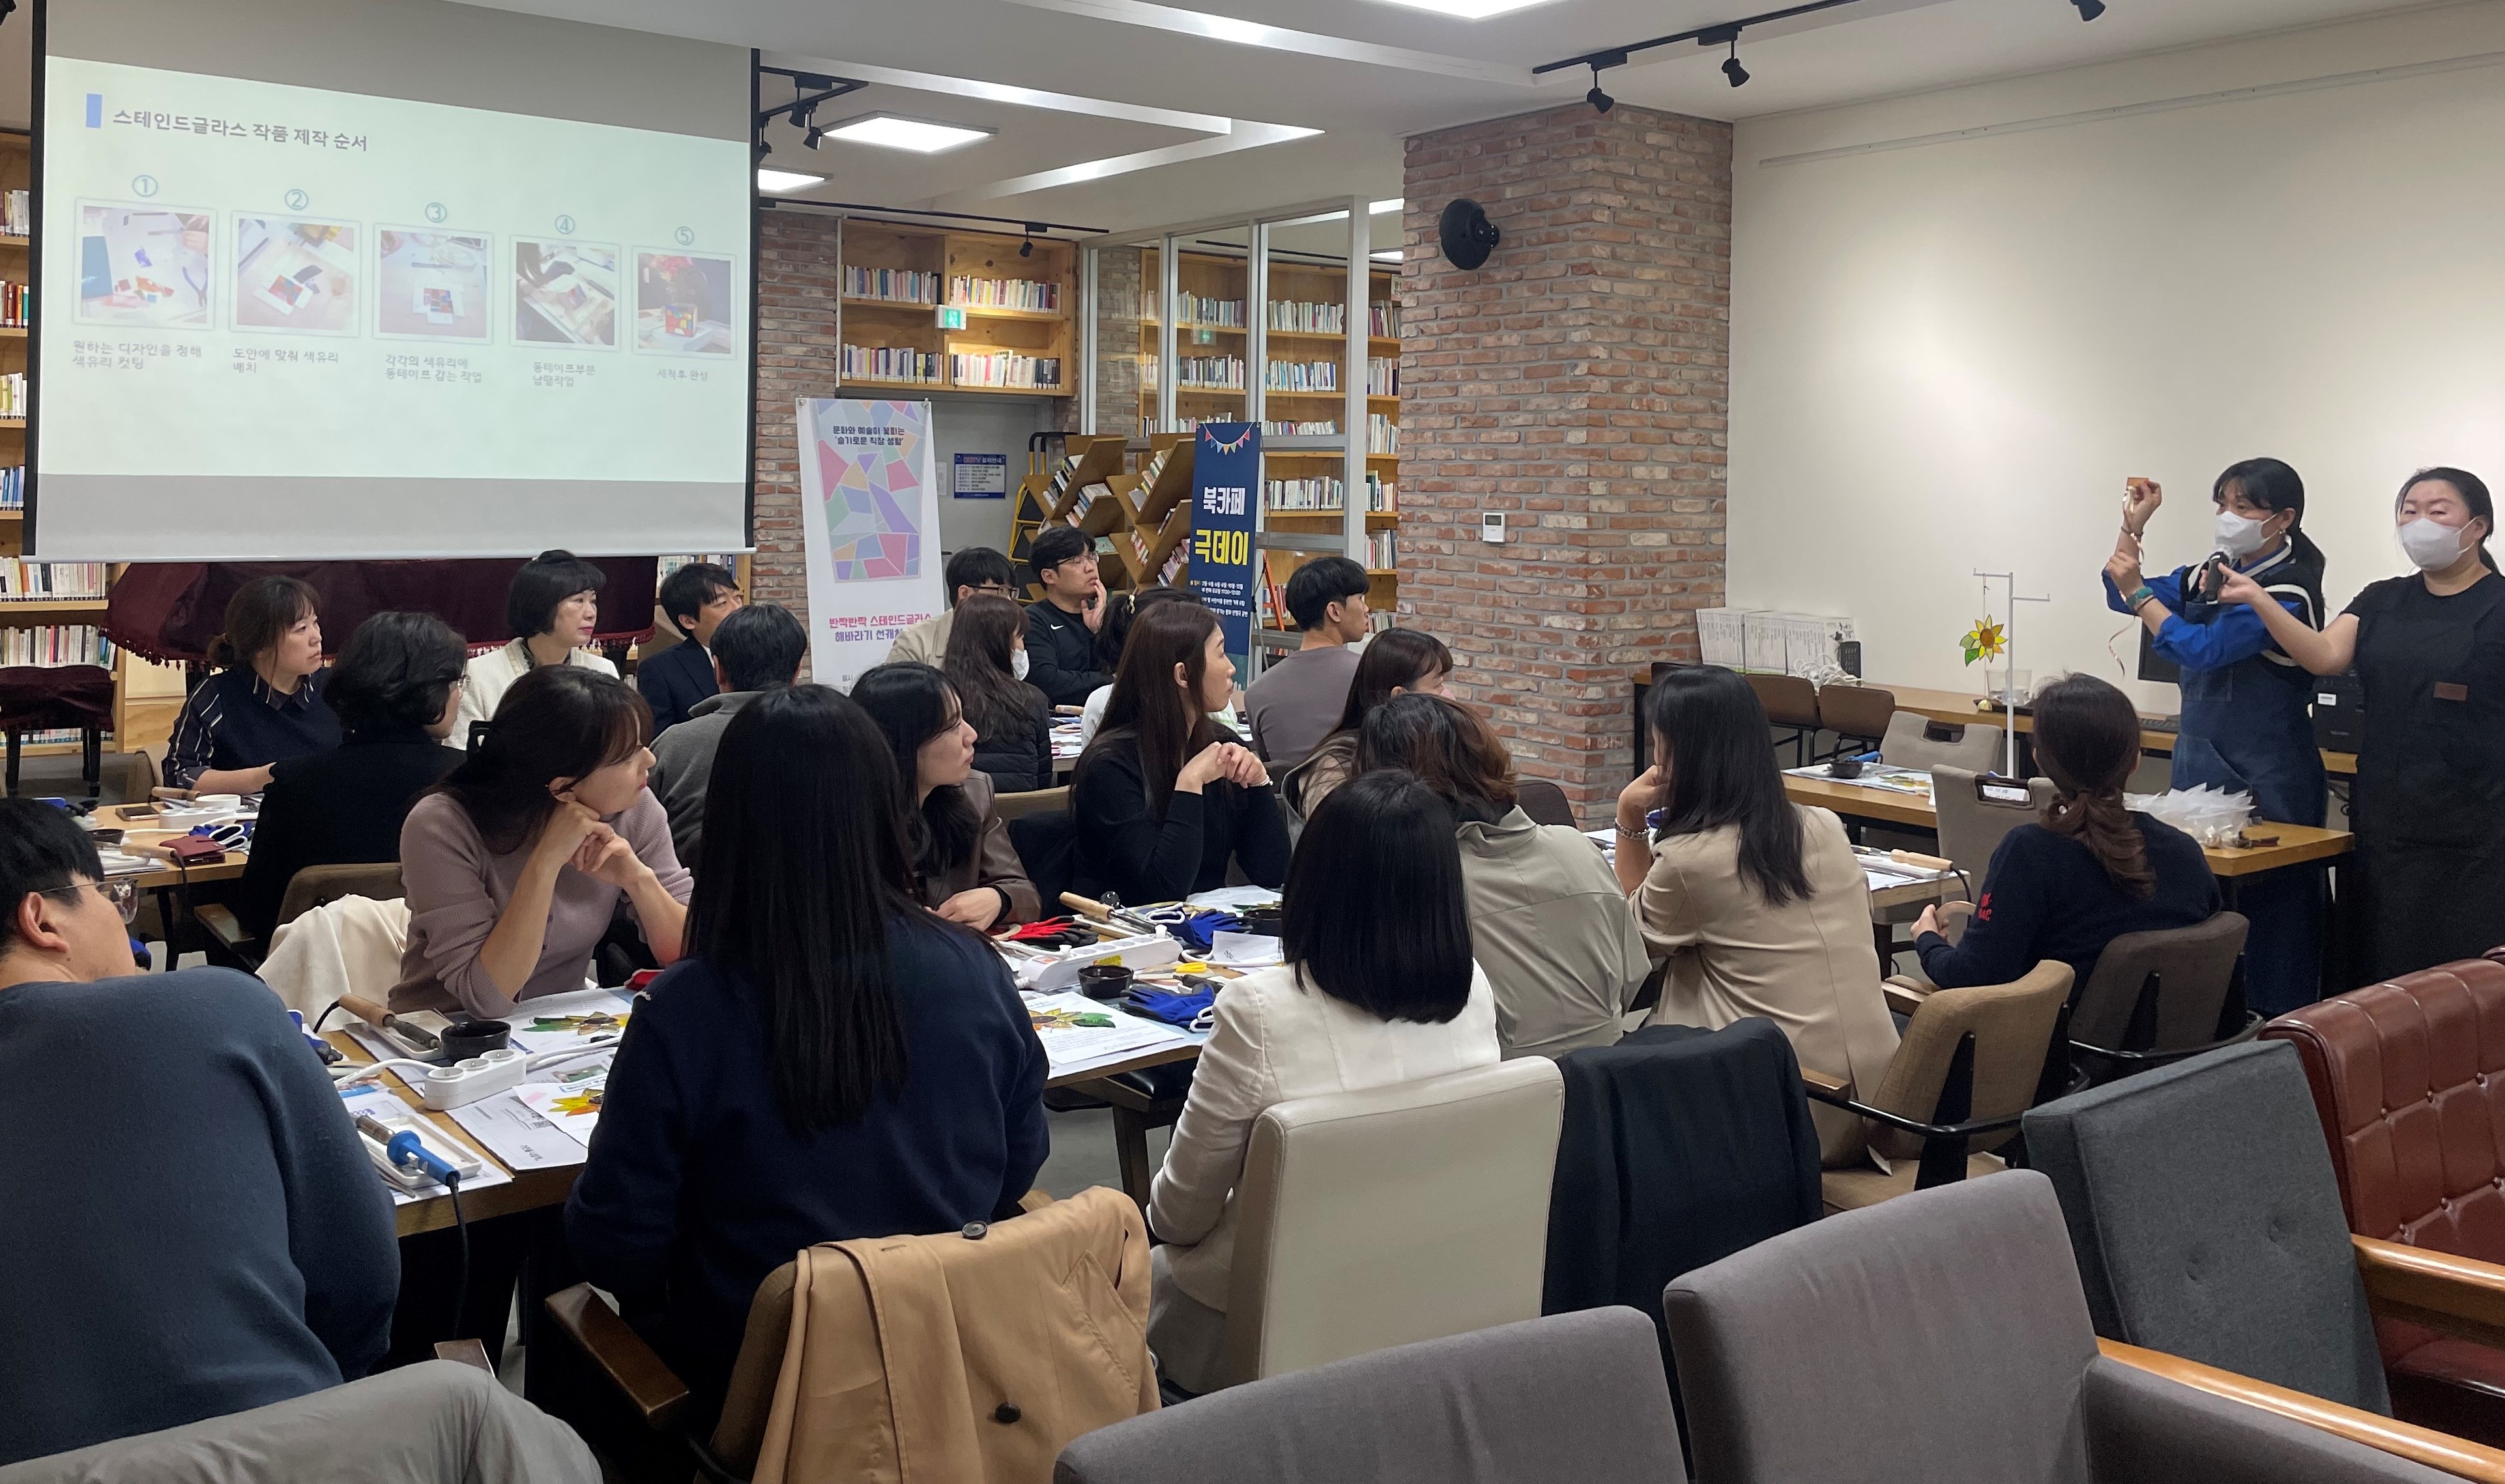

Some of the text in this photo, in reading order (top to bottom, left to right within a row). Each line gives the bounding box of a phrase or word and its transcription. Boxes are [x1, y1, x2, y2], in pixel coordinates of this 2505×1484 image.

[113, 109, 367, 151] 스테인드글라스 작품 제작 순서
[74, 341, 201, 358] 원하는 디자인을 정해
[233, 348, 270, 360] 도안에
[304, 351, 338, 364] 색유리
[72, 356, 112, 368] 색유리
[385, 354, 419, 367] 각각의
[233, 362, 256, 373] 배치
[386, 368, 431, 380] 동테이프
[461, 371, 482, 383] 작업
[833, 426, 856, 435] 문화와
[858, 427, 880, 435] 예술이
[870, 436, 885, 445] 직장
[1203, 487, 1245, 515] 북카페
[1195, 529, 1249, 565] 극데이
[830, 616, 867, 629] 반짝반짝
[835, 630, 873, 642] 해바라기
